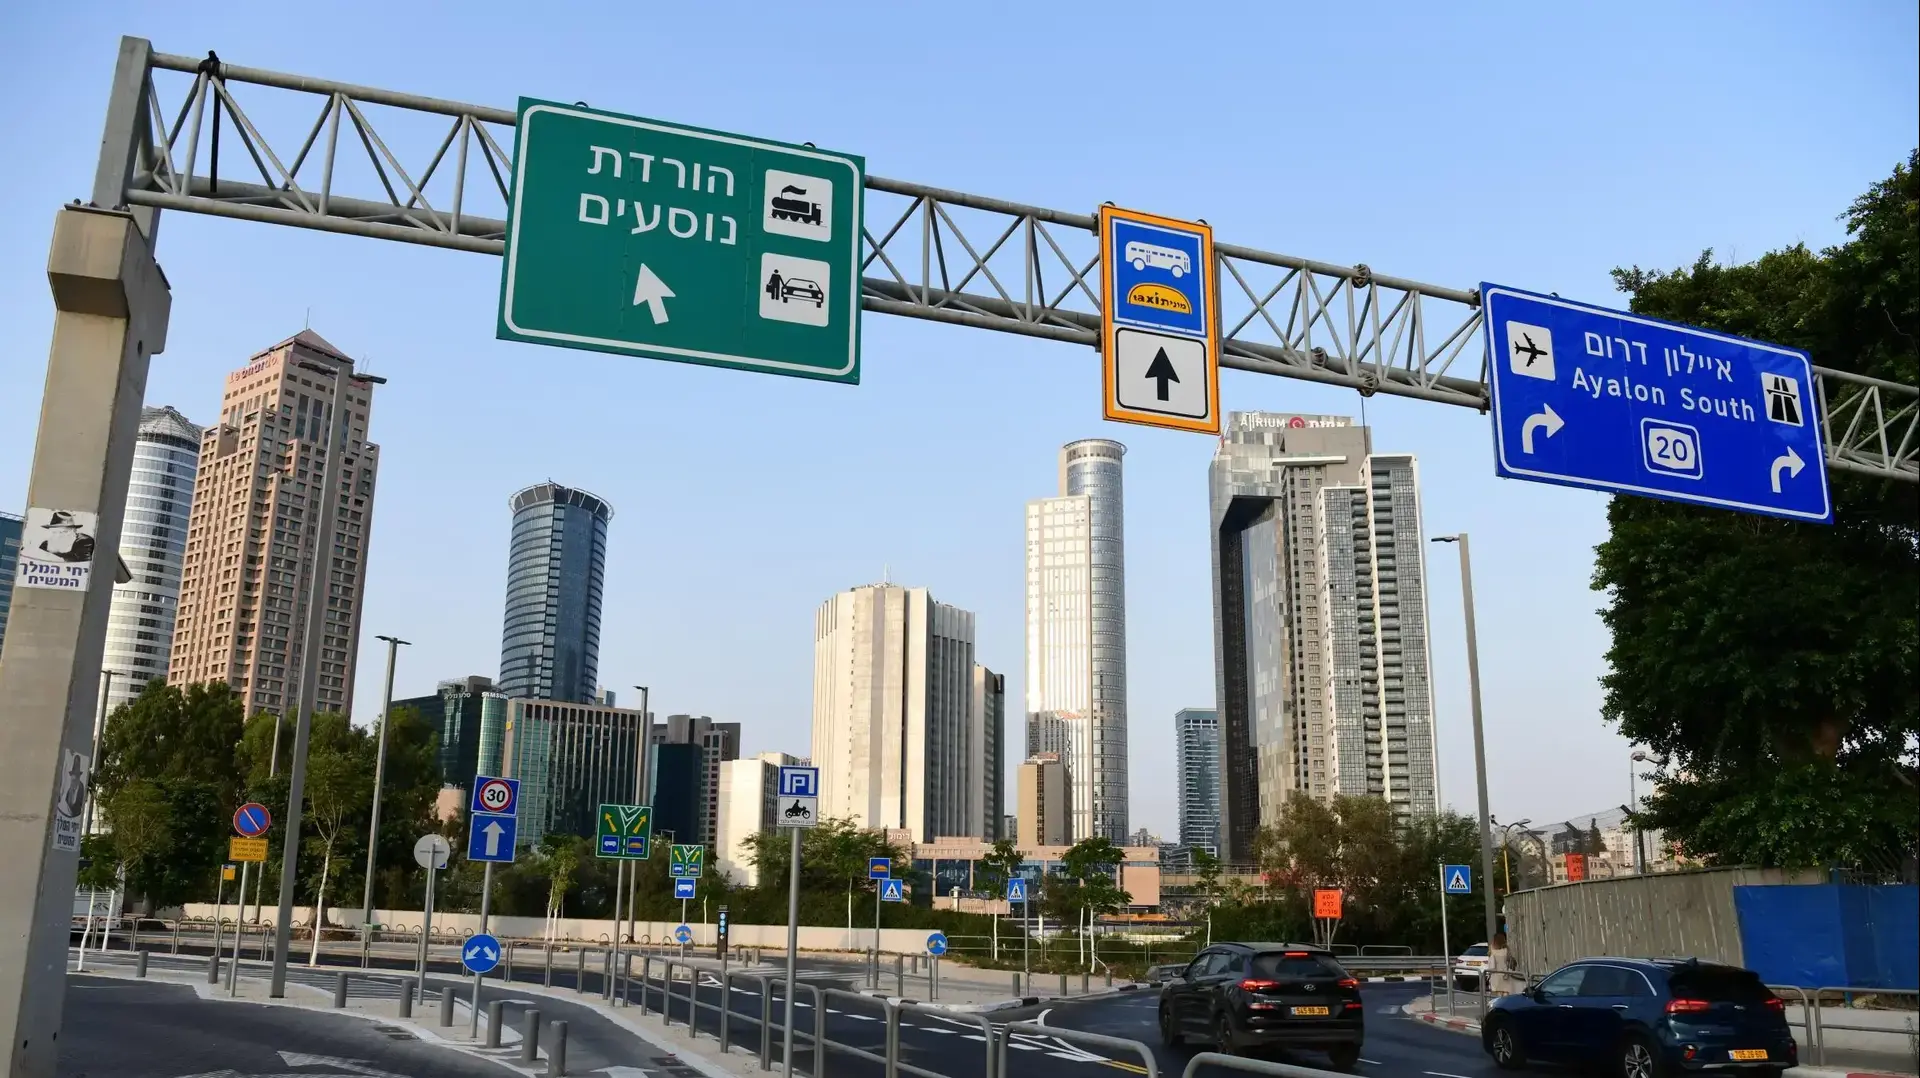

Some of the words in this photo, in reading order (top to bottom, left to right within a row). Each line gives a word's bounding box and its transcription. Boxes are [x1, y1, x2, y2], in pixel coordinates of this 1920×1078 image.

[587, 144, 735, 197] הורדת
[578, 192, 737, 246] נוסעים
[1133, 292, 1160, 305] taxi
[1584, 331, 1648, 366] דרום
[1663, 344, 1734, 383] איילון
[1572, 367, 1666, 406] Ayalon
[1681, 387, 1756, 422] South
[1655, 435, 1688, 462] 20
[20, 561, 60, 575] המלך
[28, 575, 80, 588] המשיח
[67, 566, 89, 577] יחי
[486, 788, 506, 803] 30
